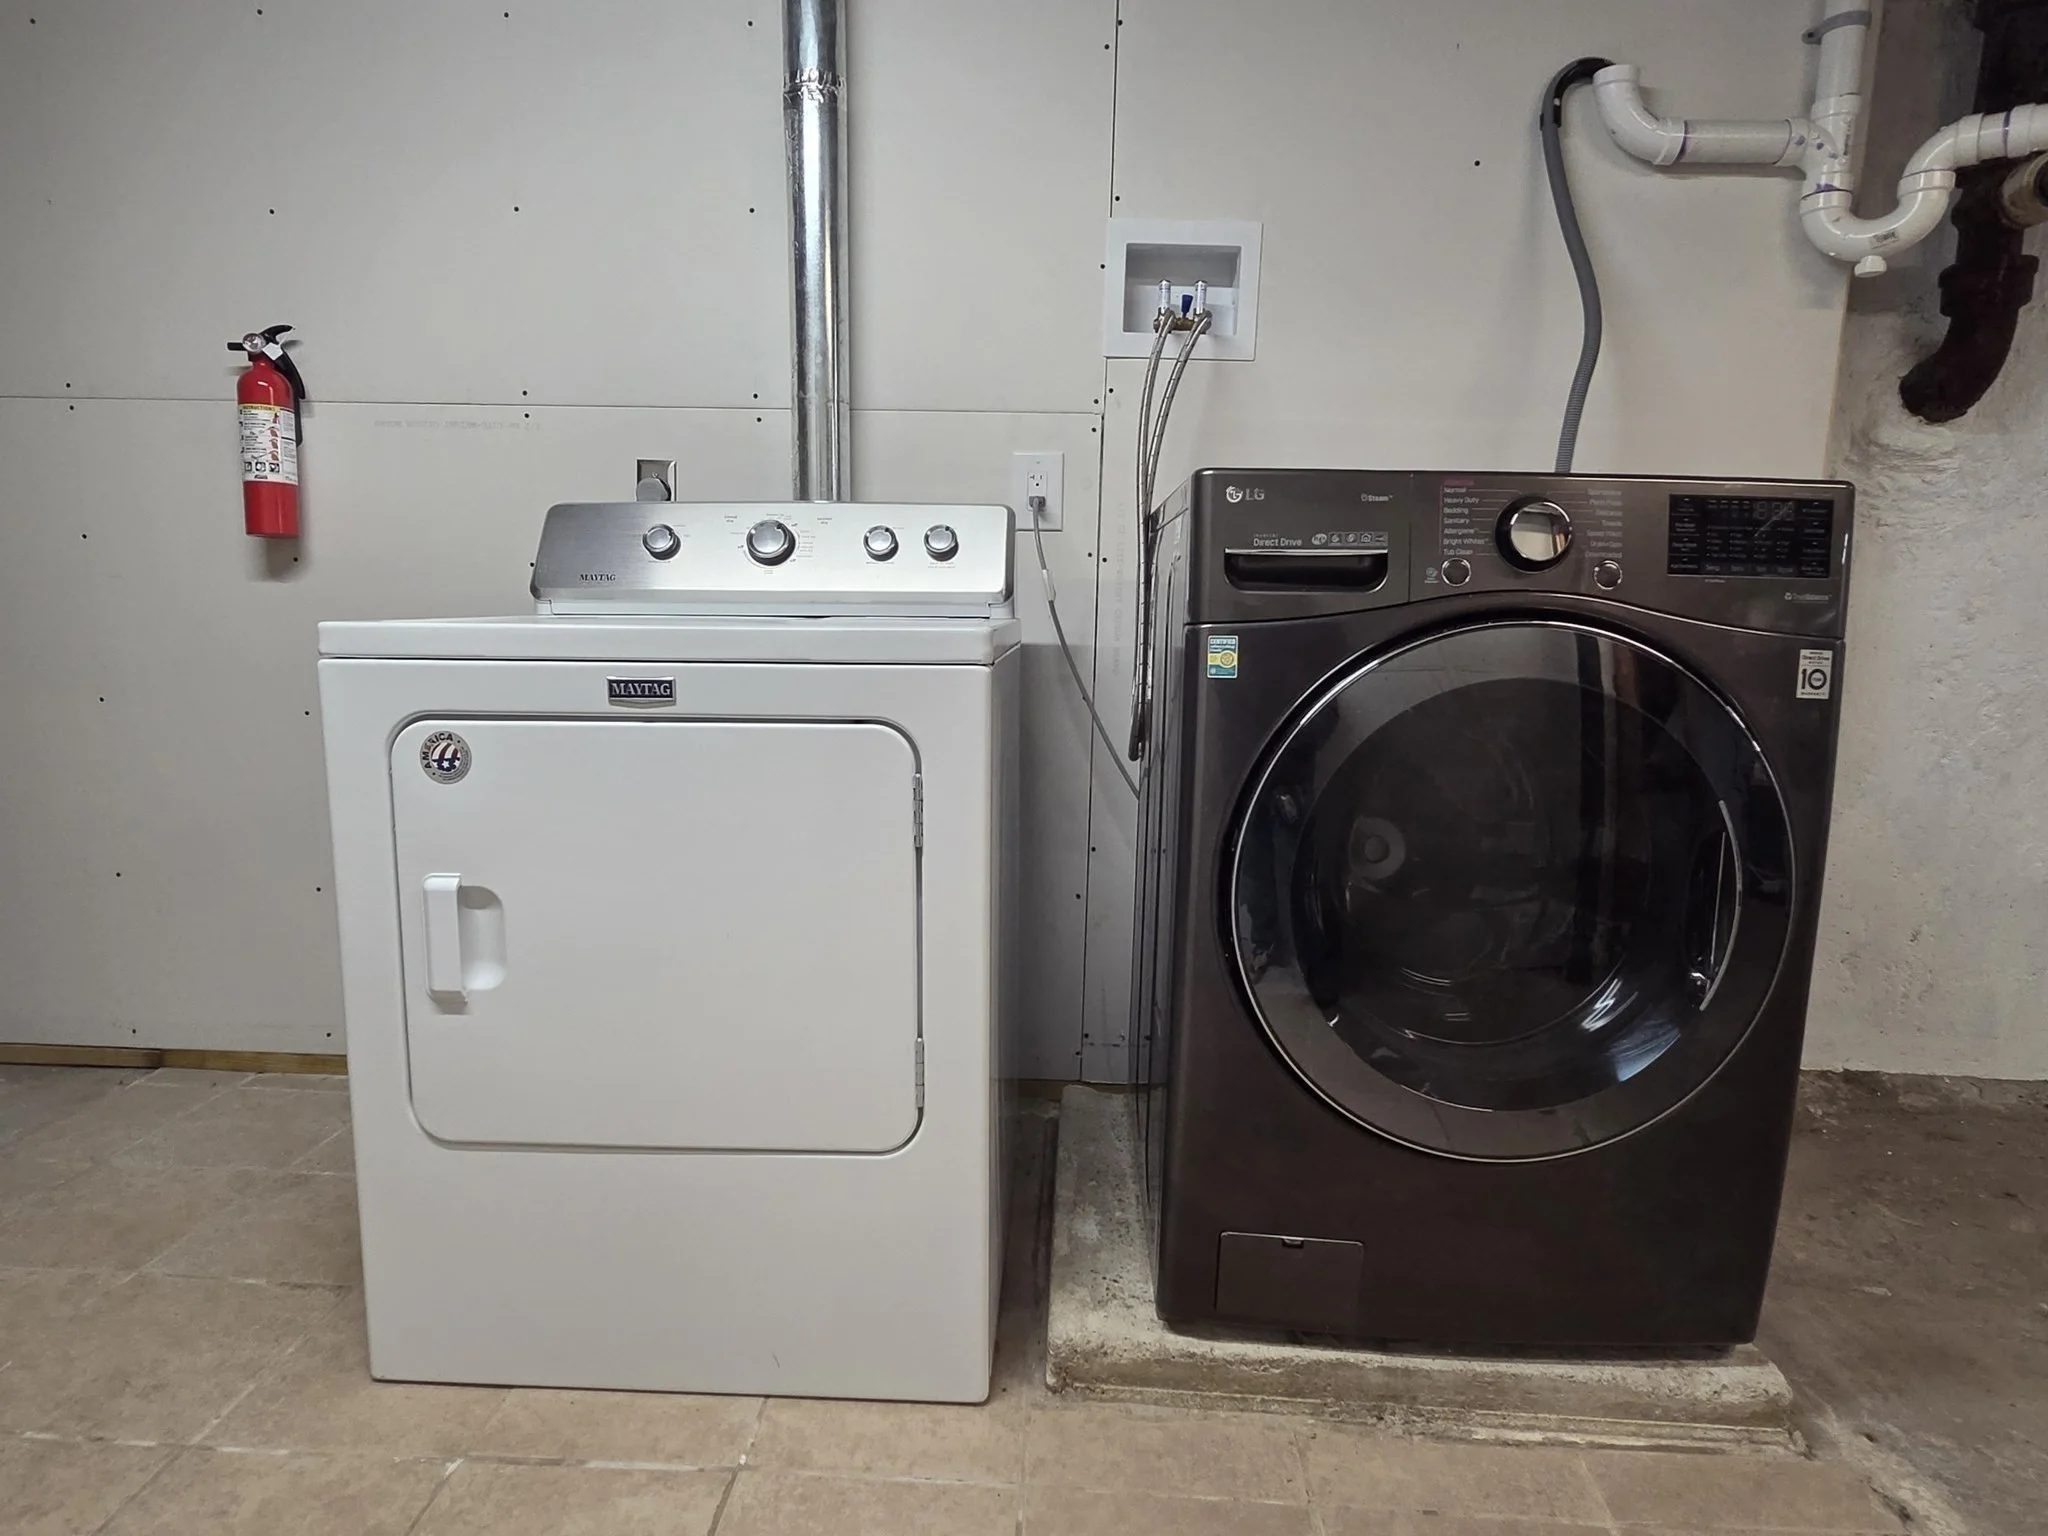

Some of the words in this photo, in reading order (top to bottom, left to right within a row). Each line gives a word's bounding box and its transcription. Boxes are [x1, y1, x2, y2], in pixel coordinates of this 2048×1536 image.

[1245, 487, 1265, 501] LG
[1253, 538, 1279, 547] Direct
[1280, 538, 1302, 547] Drive
[1443, 538, 1462, 546] Bright
[1801, 668, 1827, 690] 10
[611, 683, 671, 695] MAYTAG
[422, 732, 453, 769] AMERICA
